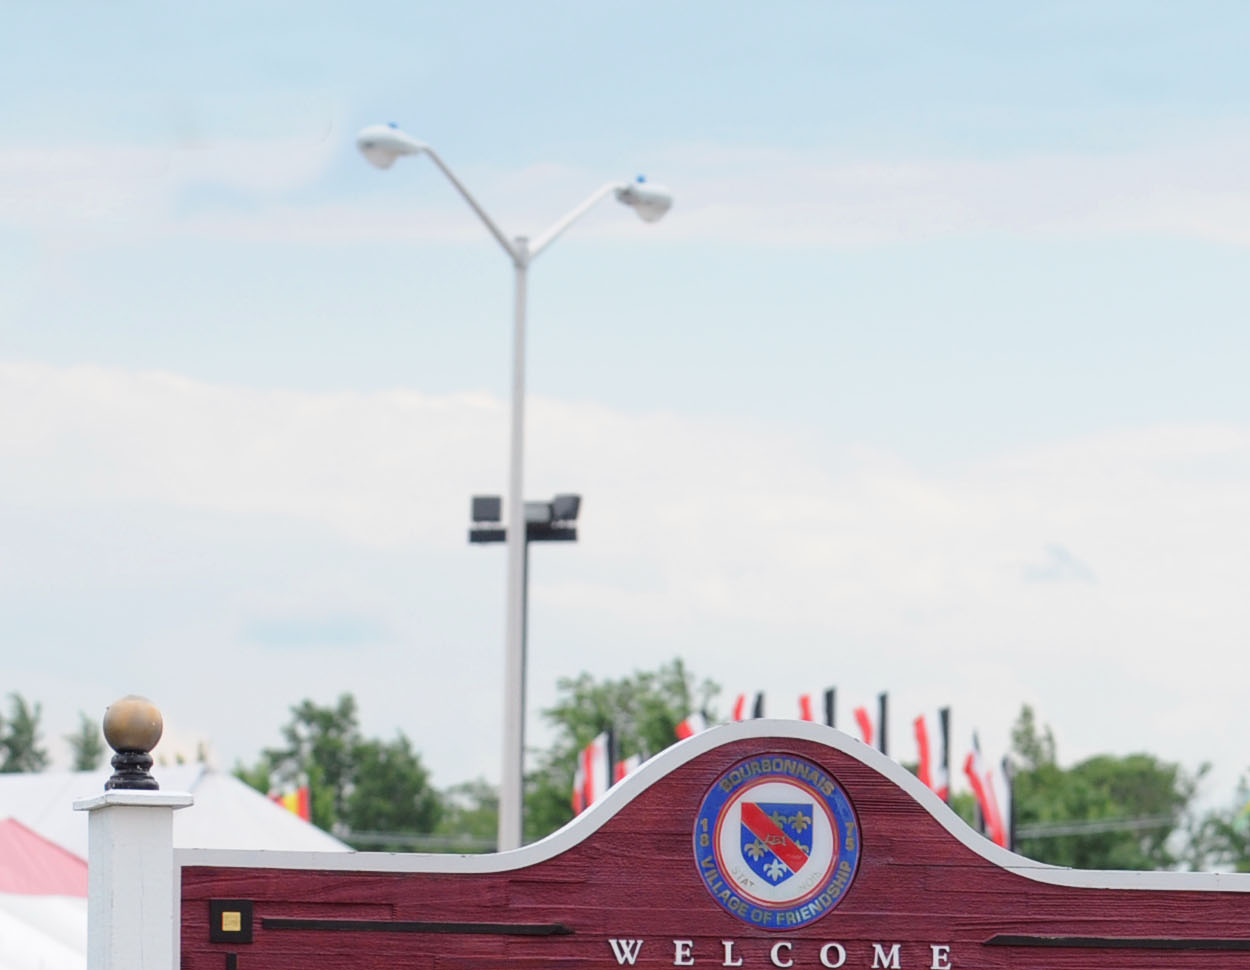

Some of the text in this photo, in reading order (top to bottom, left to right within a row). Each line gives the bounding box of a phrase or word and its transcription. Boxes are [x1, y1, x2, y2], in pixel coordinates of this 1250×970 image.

[719, 758, 836, 797] BOURBONNAIS
[701, 855, 852, 926] VILLAGE OF FRIENDSHIP
[608, 938, 953, 970] WELCOME
